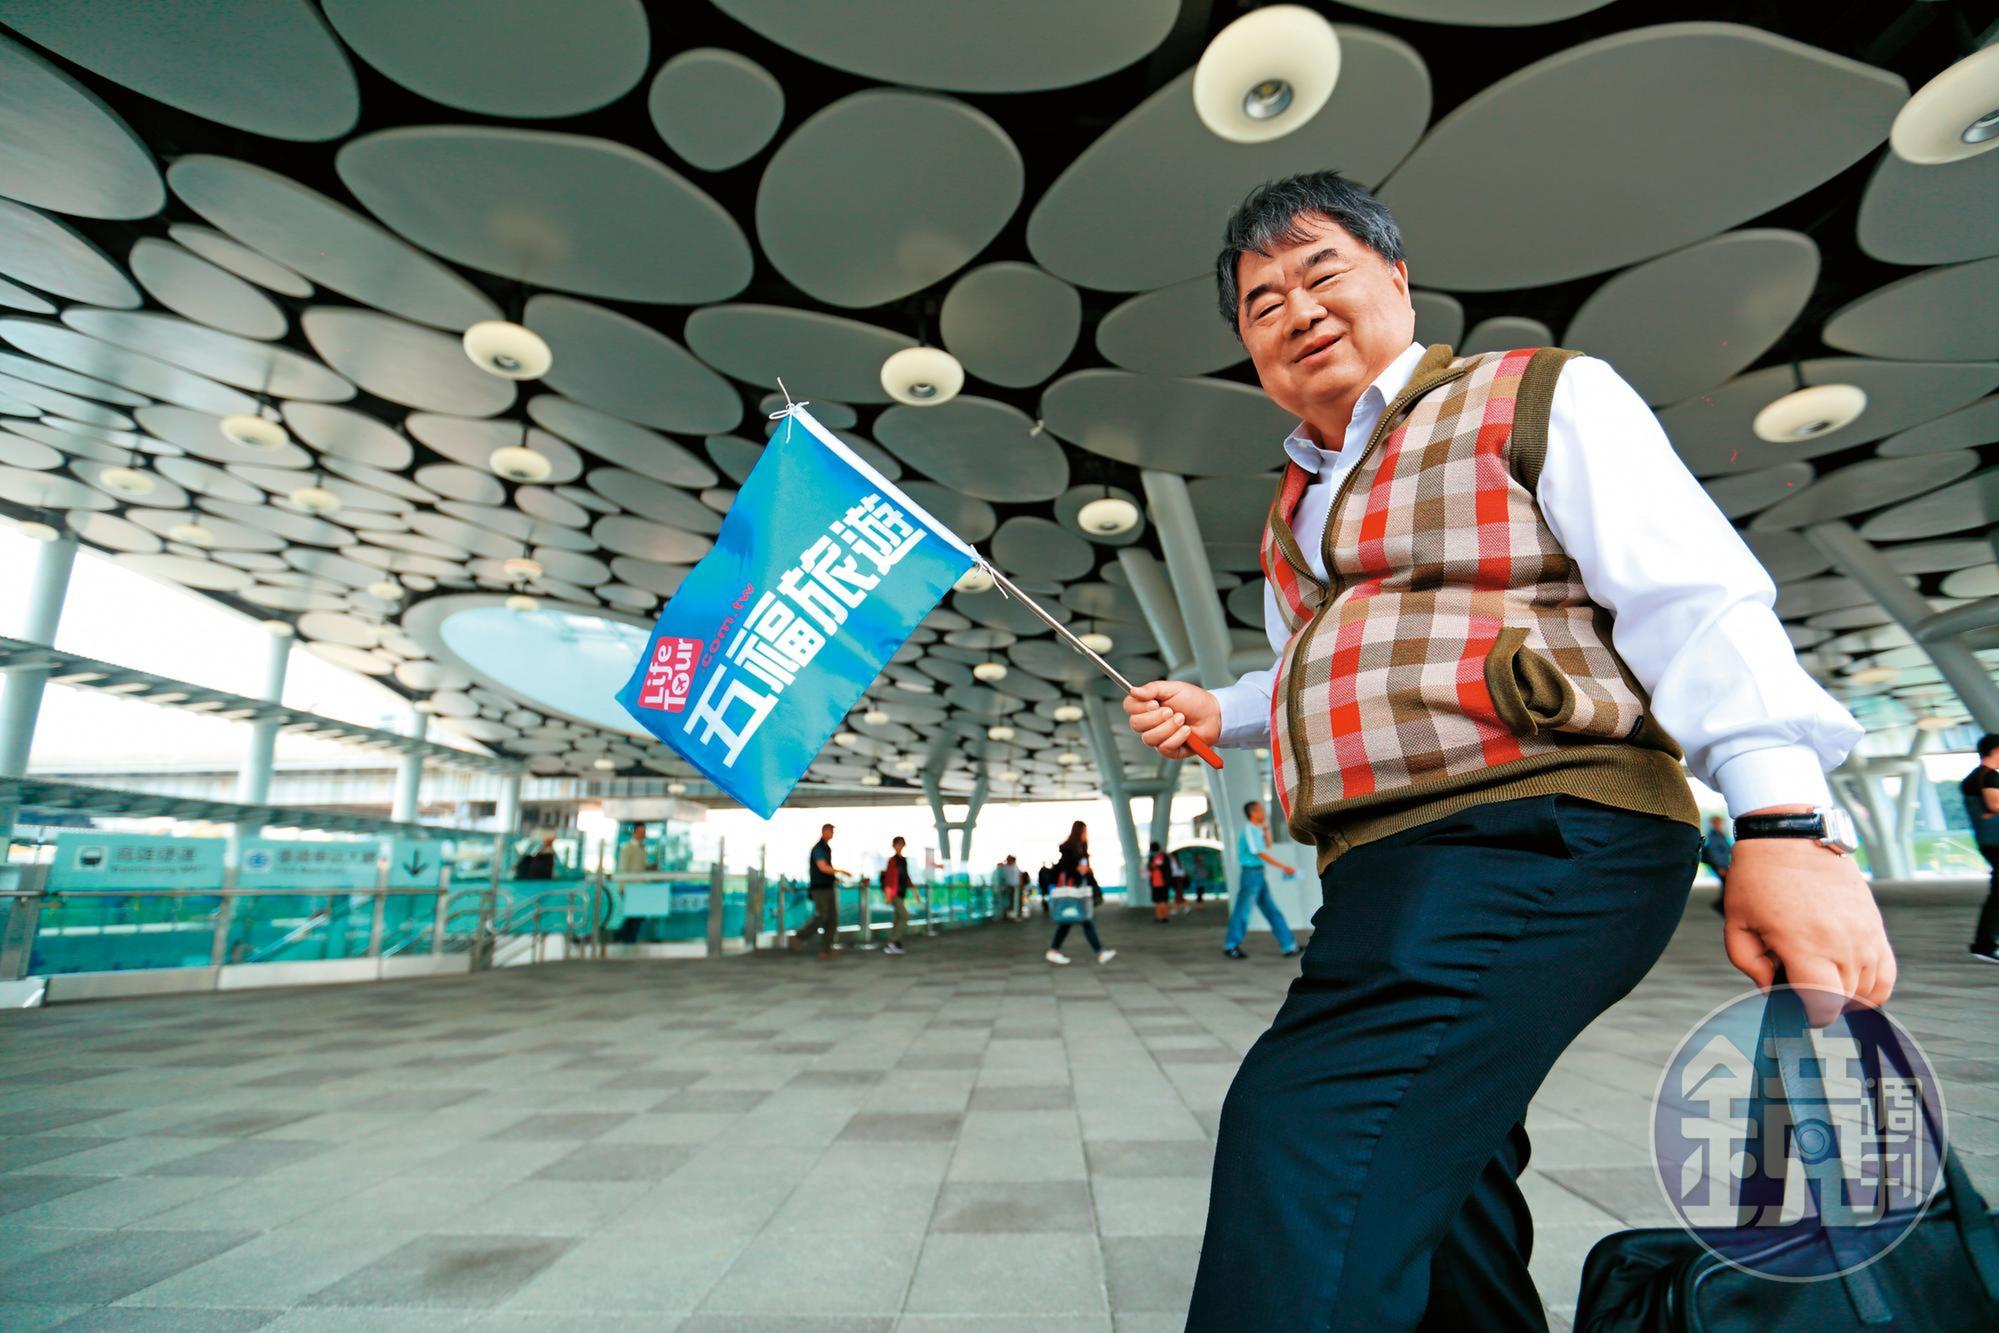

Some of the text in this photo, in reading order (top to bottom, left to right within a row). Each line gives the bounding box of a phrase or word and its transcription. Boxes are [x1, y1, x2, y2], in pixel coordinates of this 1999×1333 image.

[683, 493, 927, 768] 五福旅遊
[644, 643, 672, 704] Life
[664, 638, 693, 711] Tour
